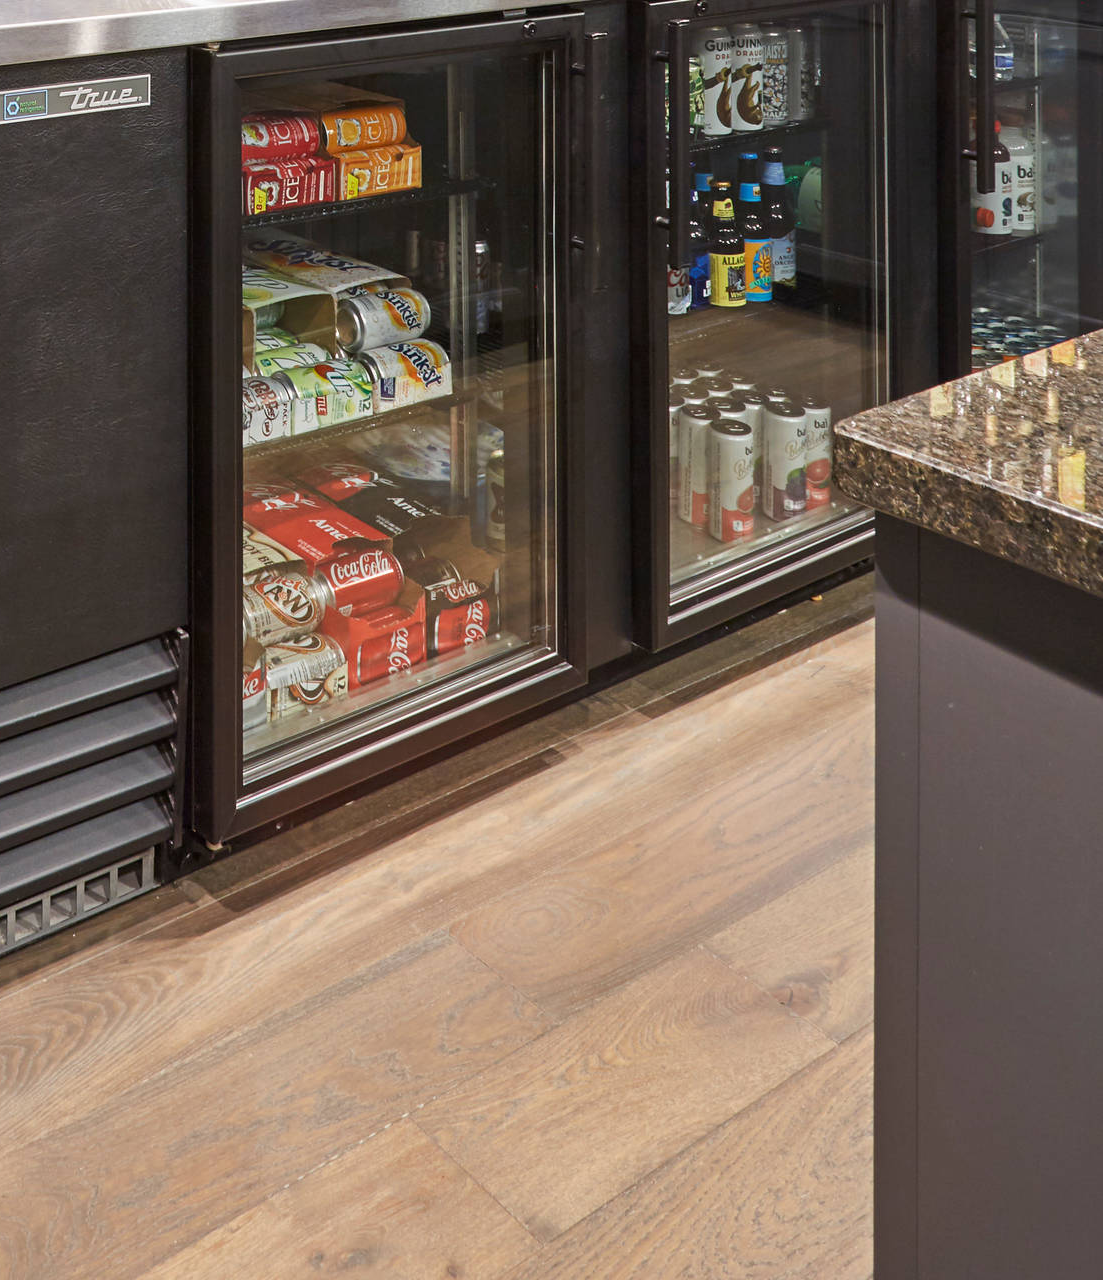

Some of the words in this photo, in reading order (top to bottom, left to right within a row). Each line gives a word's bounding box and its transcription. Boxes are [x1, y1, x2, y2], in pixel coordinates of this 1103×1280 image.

[366, 113, 381, 145] ICE
[285, 177, 300, 205] ICE
[375, 163, 391, 191] ICE
[814, 419, 828, 429] bai
[330, 549, 391, 588] Coca-Cola
[264, 584, 312, 620] A&W
